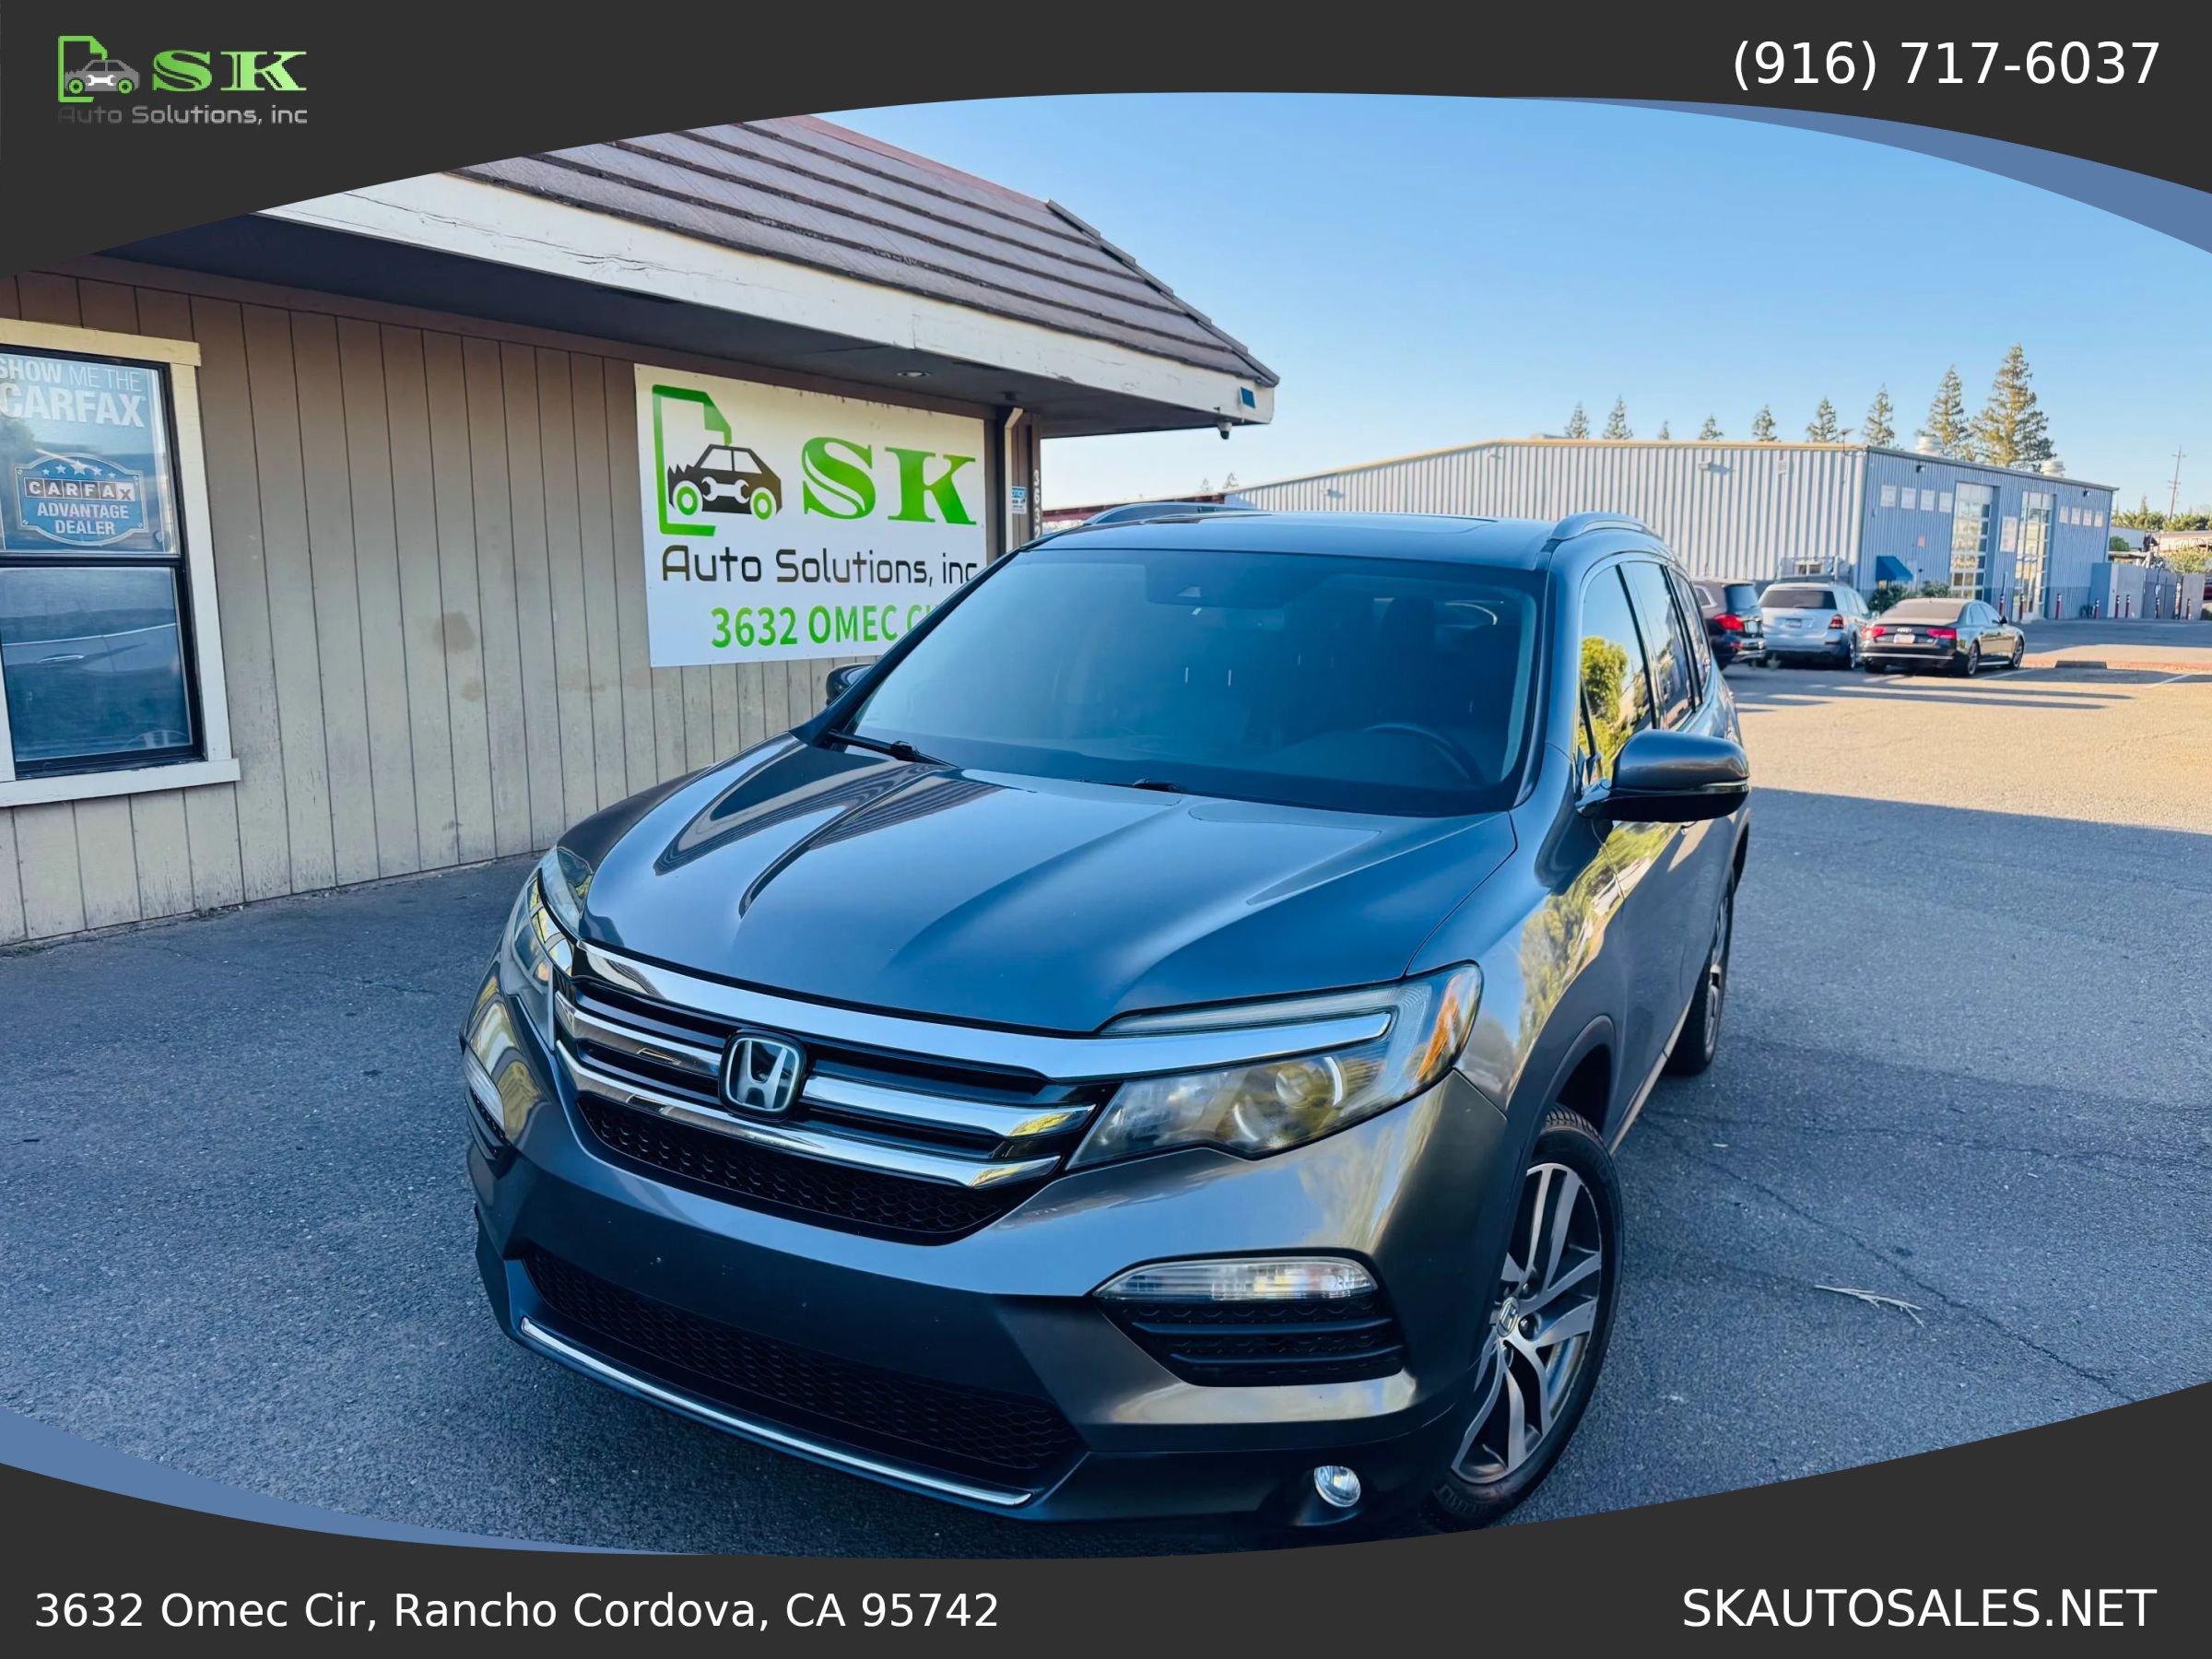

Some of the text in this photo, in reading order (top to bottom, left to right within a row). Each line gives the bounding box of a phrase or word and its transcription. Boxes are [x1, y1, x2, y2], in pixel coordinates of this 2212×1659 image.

[69, 366, 100, 388] ME
[103, 369, 141, 392] THE
[0, 382, 145, 428] CARFAX
[29, 481, 131, 500] CARFAX
[802, 437, 977, 525] SK
[37, 502, 130, 519] ADVANTAGE
[54, 520, 116, 535] DEALER
[662, 545, 977, 587] Auto Solutions, inc
[711, 606, 797, 648] 3632
[808, 605, 898, 643] OMEC
